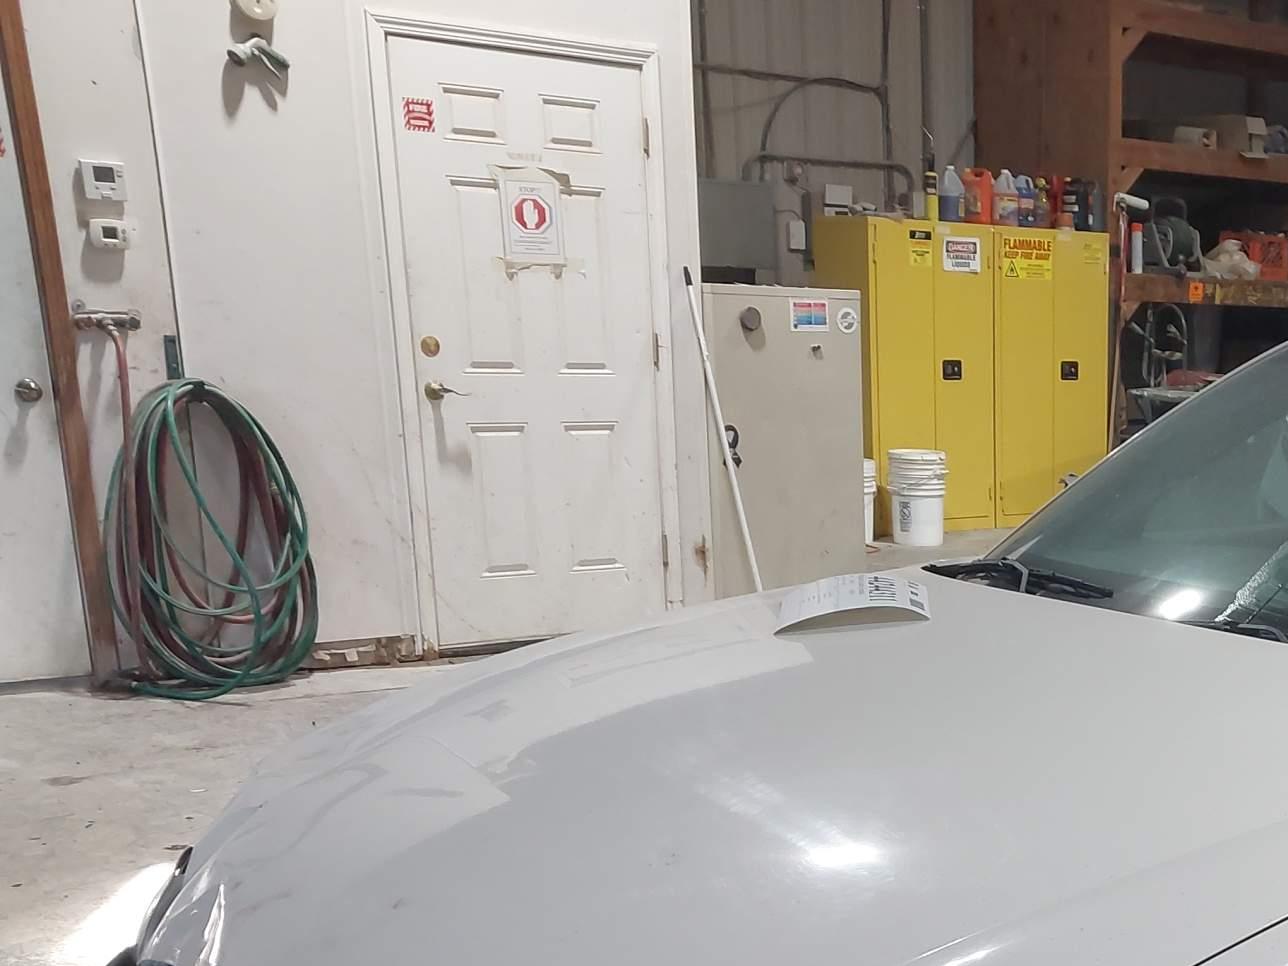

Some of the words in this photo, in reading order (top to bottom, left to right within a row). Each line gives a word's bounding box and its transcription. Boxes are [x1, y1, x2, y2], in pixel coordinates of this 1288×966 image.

[948, 242, 975, 253] DANGER
[1003, 238, 1052, 252] FLAMMABLE
[946, 253, 976, 261] FLAMMABLE
